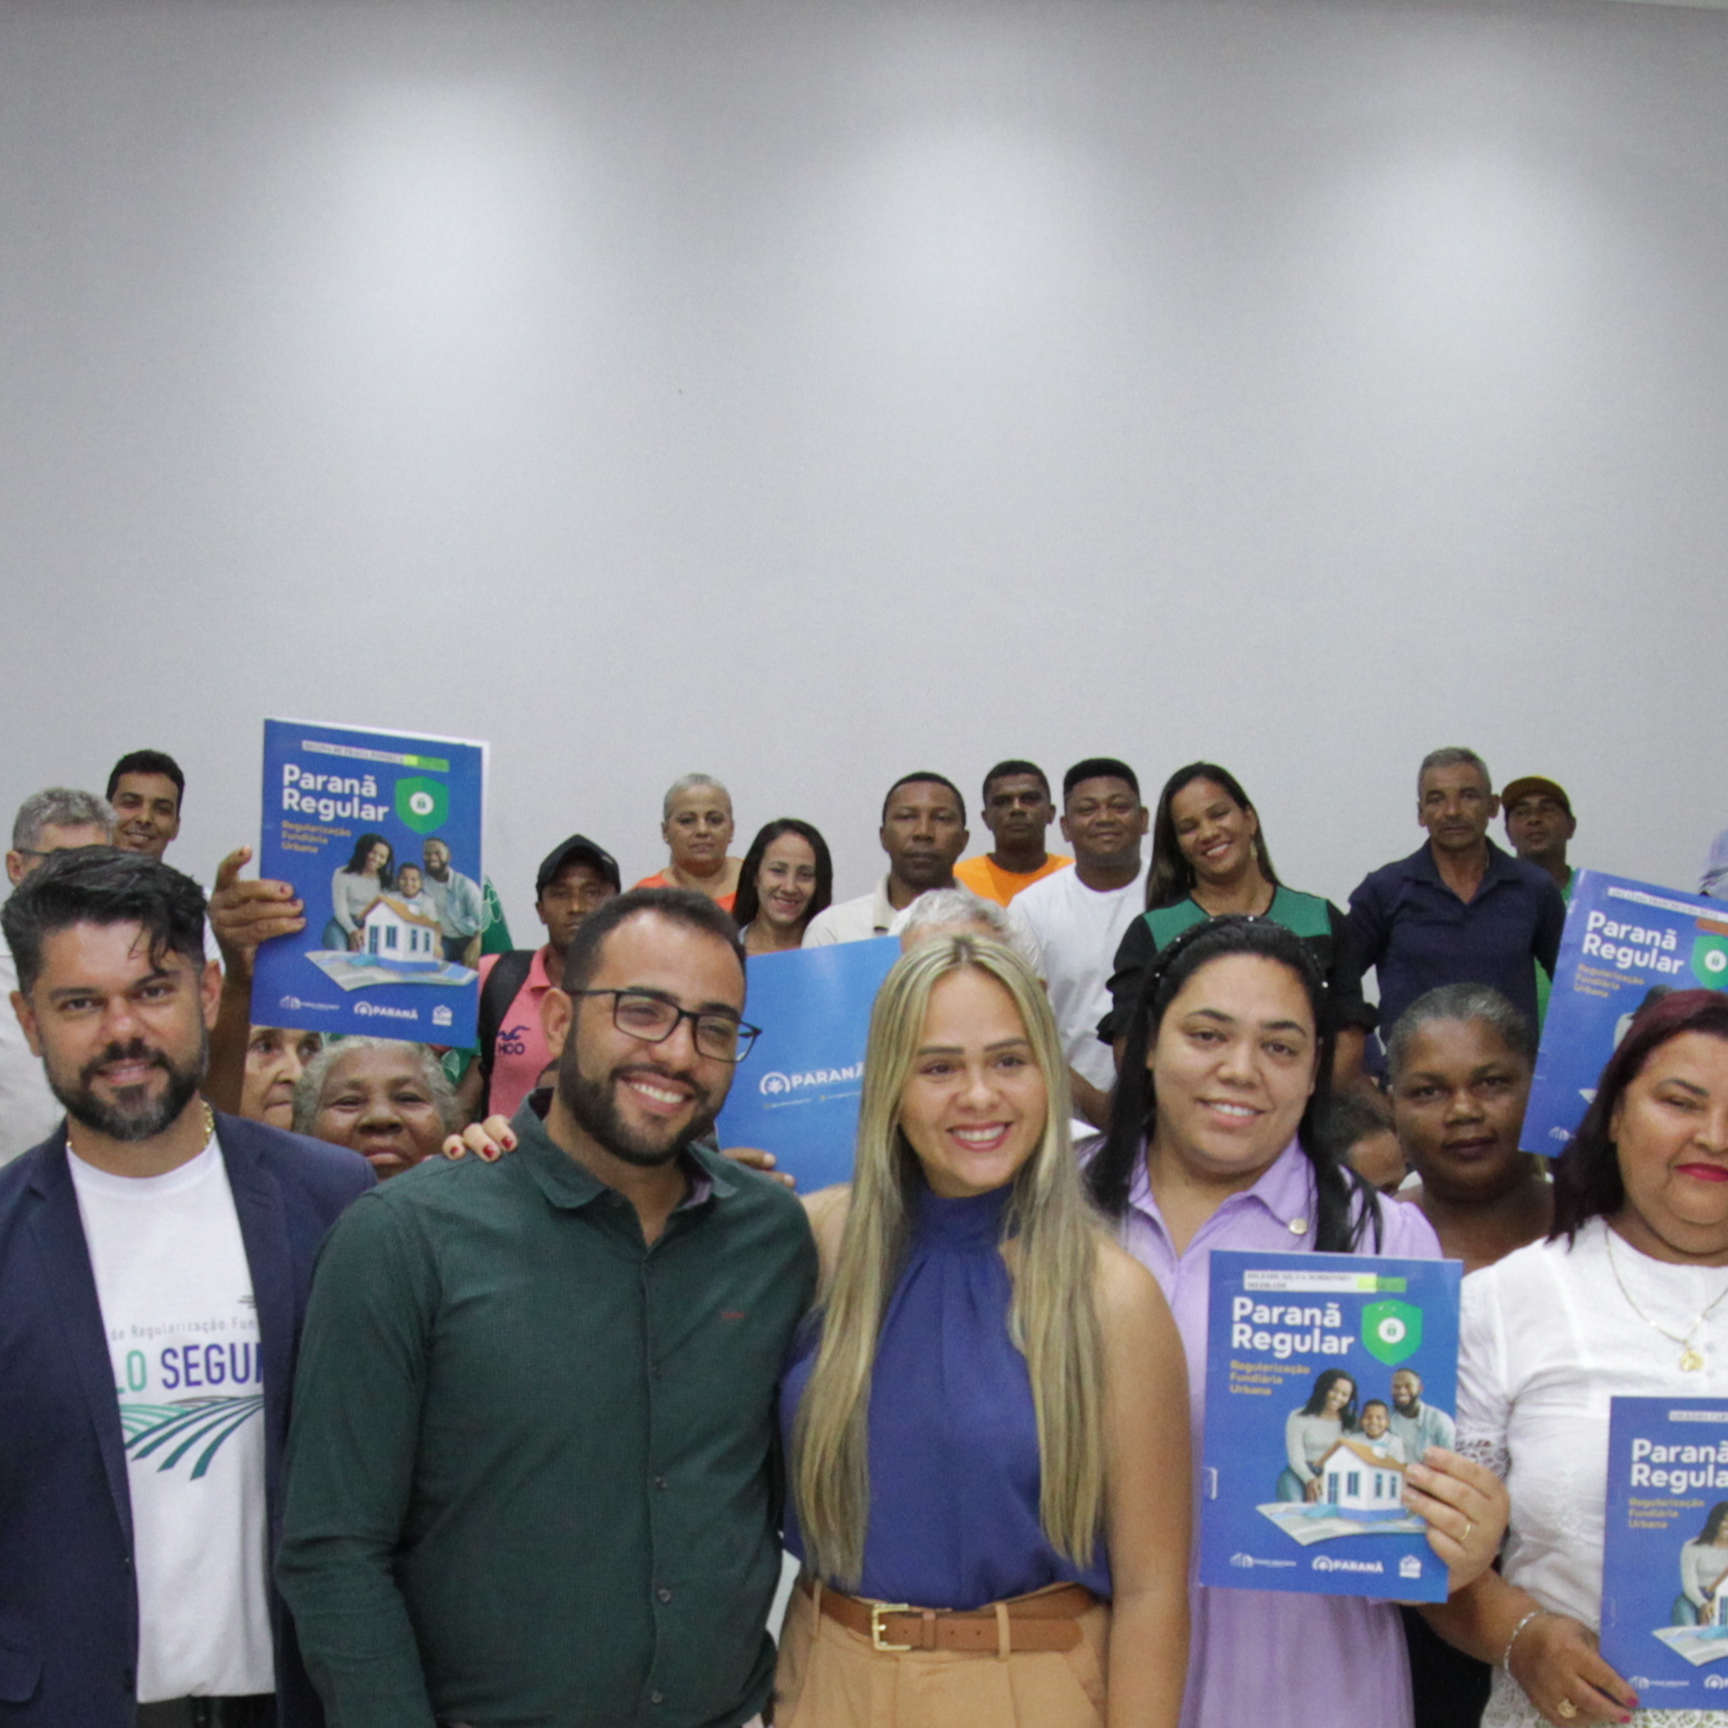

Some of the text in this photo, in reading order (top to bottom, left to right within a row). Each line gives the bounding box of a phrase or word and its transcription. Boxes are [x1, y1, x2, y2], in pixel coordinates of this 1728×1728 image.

[282, 763, 378, 798] Paranã
[282, 787, 390, 822] Regular
[1586, 910, 1678, 951] Paranã
[1581, 933, 1685, 975] Regular
[130, 1318, 226, 1340] Regularização
[1232, 1296, 1341, 1328] Paranã
[1231, 1324, 1355, 1359] Regular
